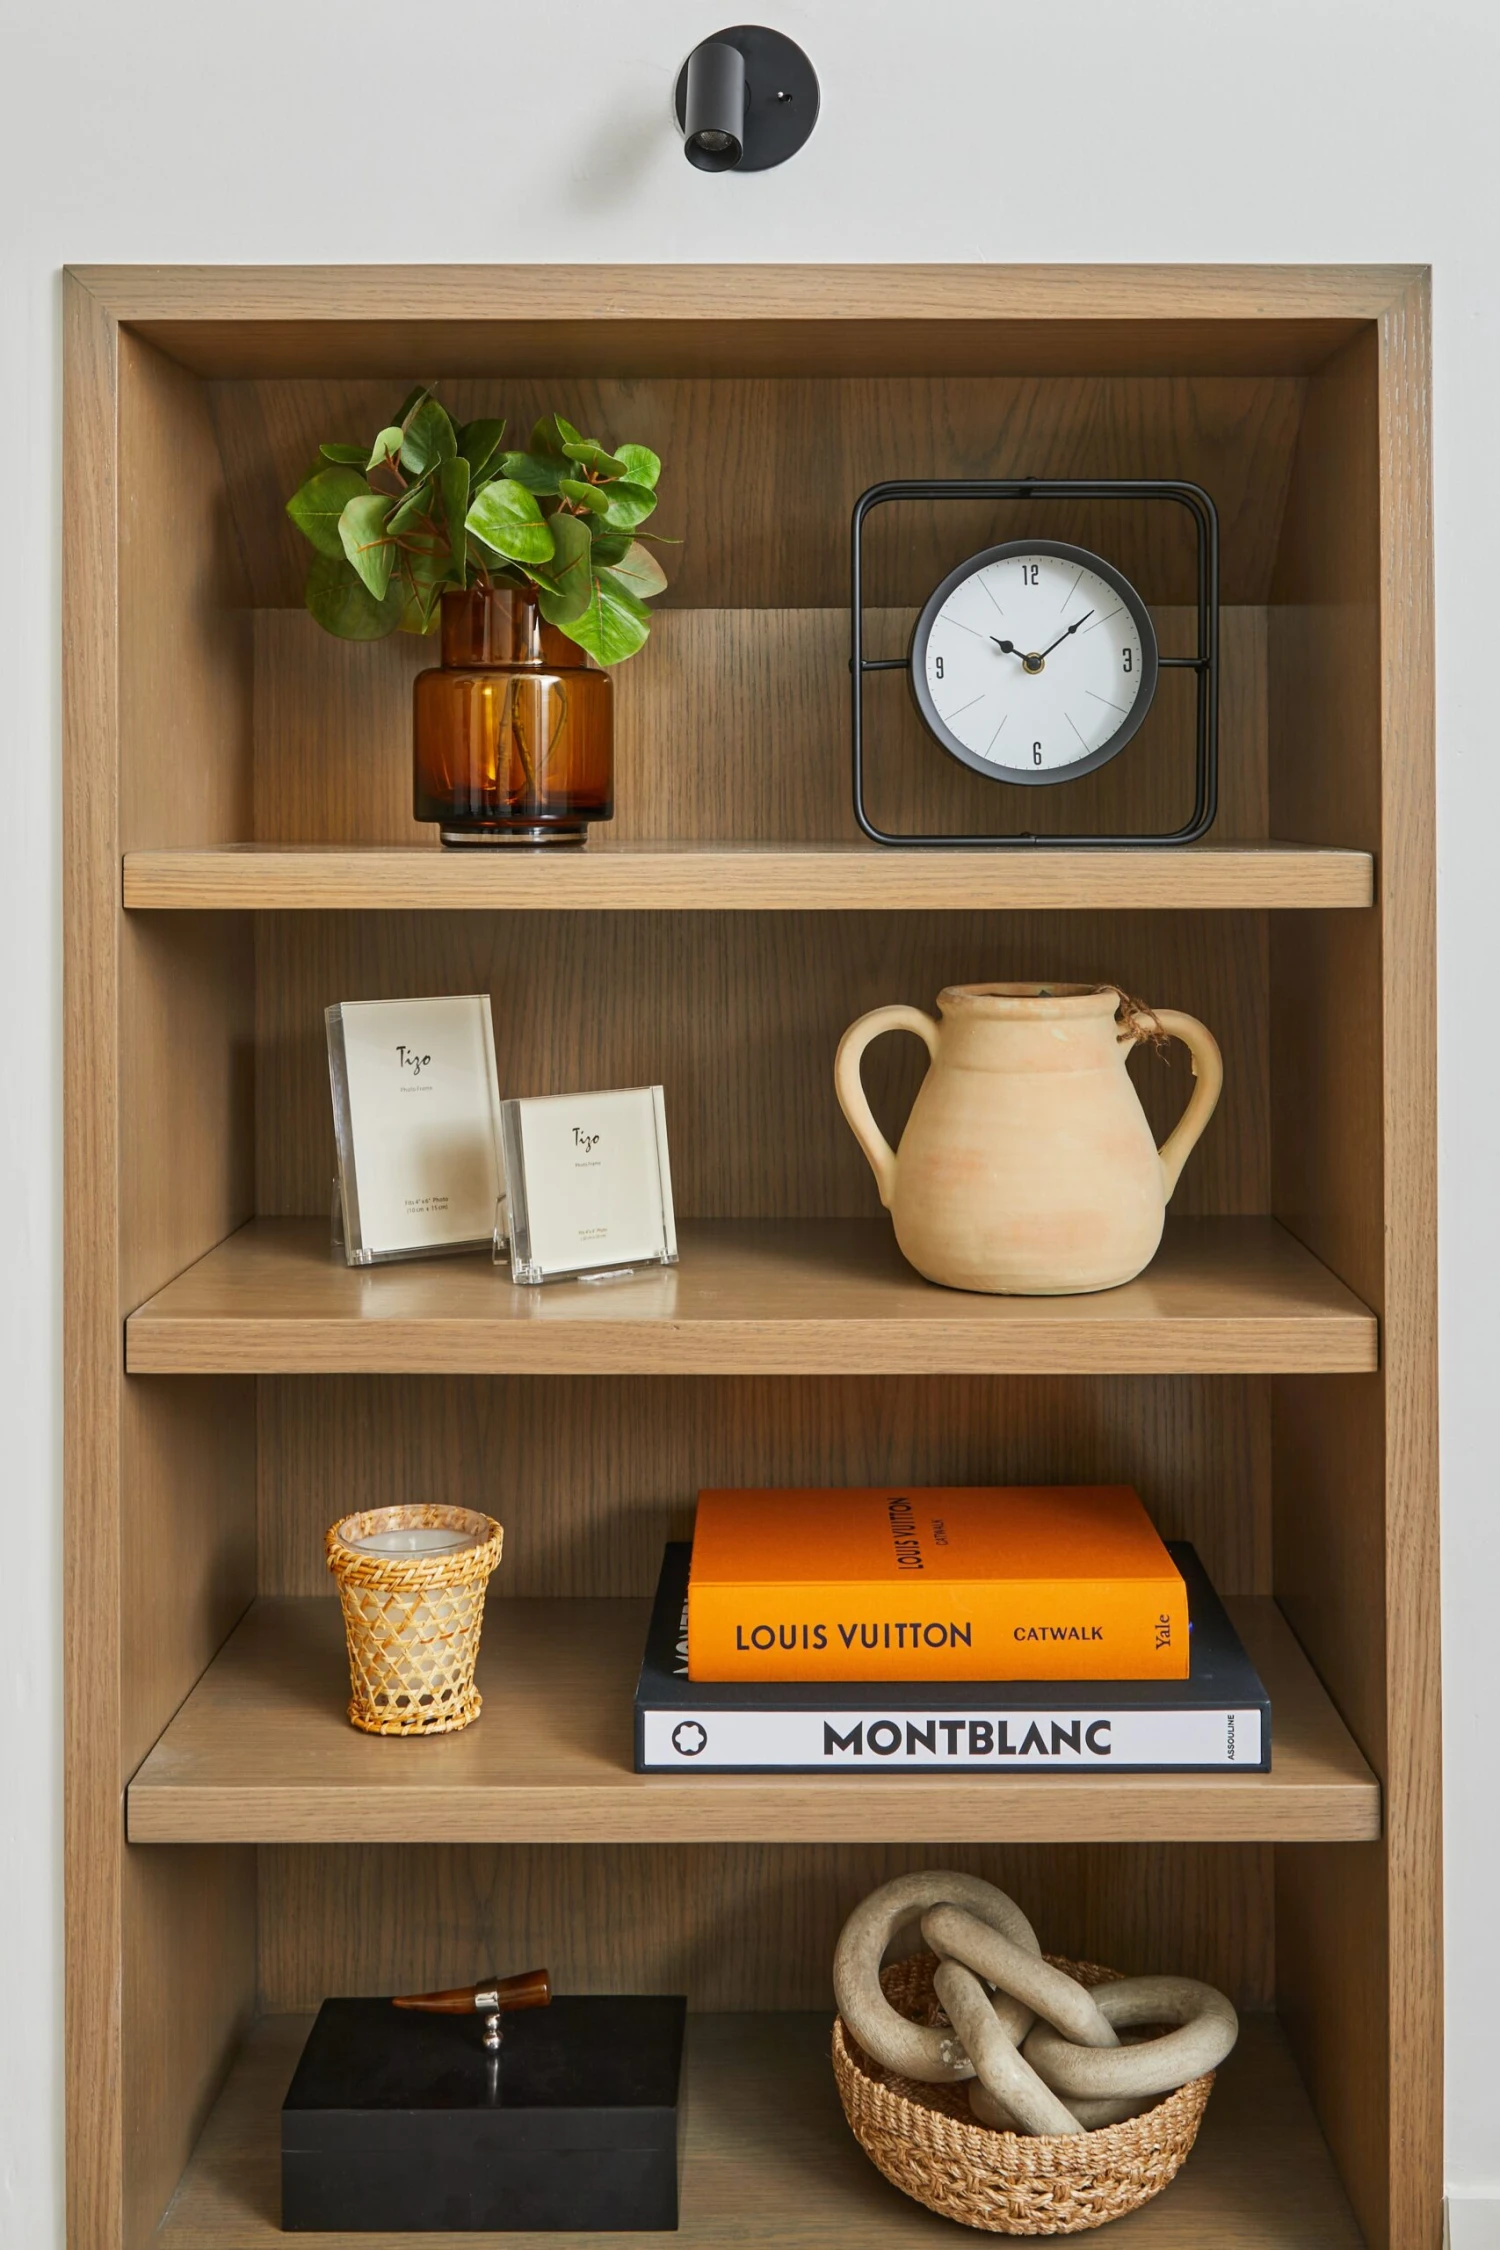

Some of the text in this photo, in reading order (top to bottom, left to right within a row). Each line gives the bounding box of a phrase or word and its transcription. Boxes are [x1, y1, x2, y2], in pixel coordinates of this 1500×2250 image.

[1022, 564, 1039, 586] 12
[936, 657, 945, 680] 9
[1123, 648, 1132, 673] 3
[1032, 742, 1042, 766] 6
[396, 1046, 431, 1076] Tizo
[572, 1127, 600, 1153] Tizo
[887, 1497, 924, 1570] LOUIS VUITTON
[932, 1519, 949, 1546] CATWALK
[736, 1621, 1104, 1651] LOUIS VUITTON CATWALK
[1154, 1614, 1171, 1650] Yale
[823, 1719, 1112, 1756] MONTBLANC
[1227, 1714, 1236, 1761] ASSOULINE
